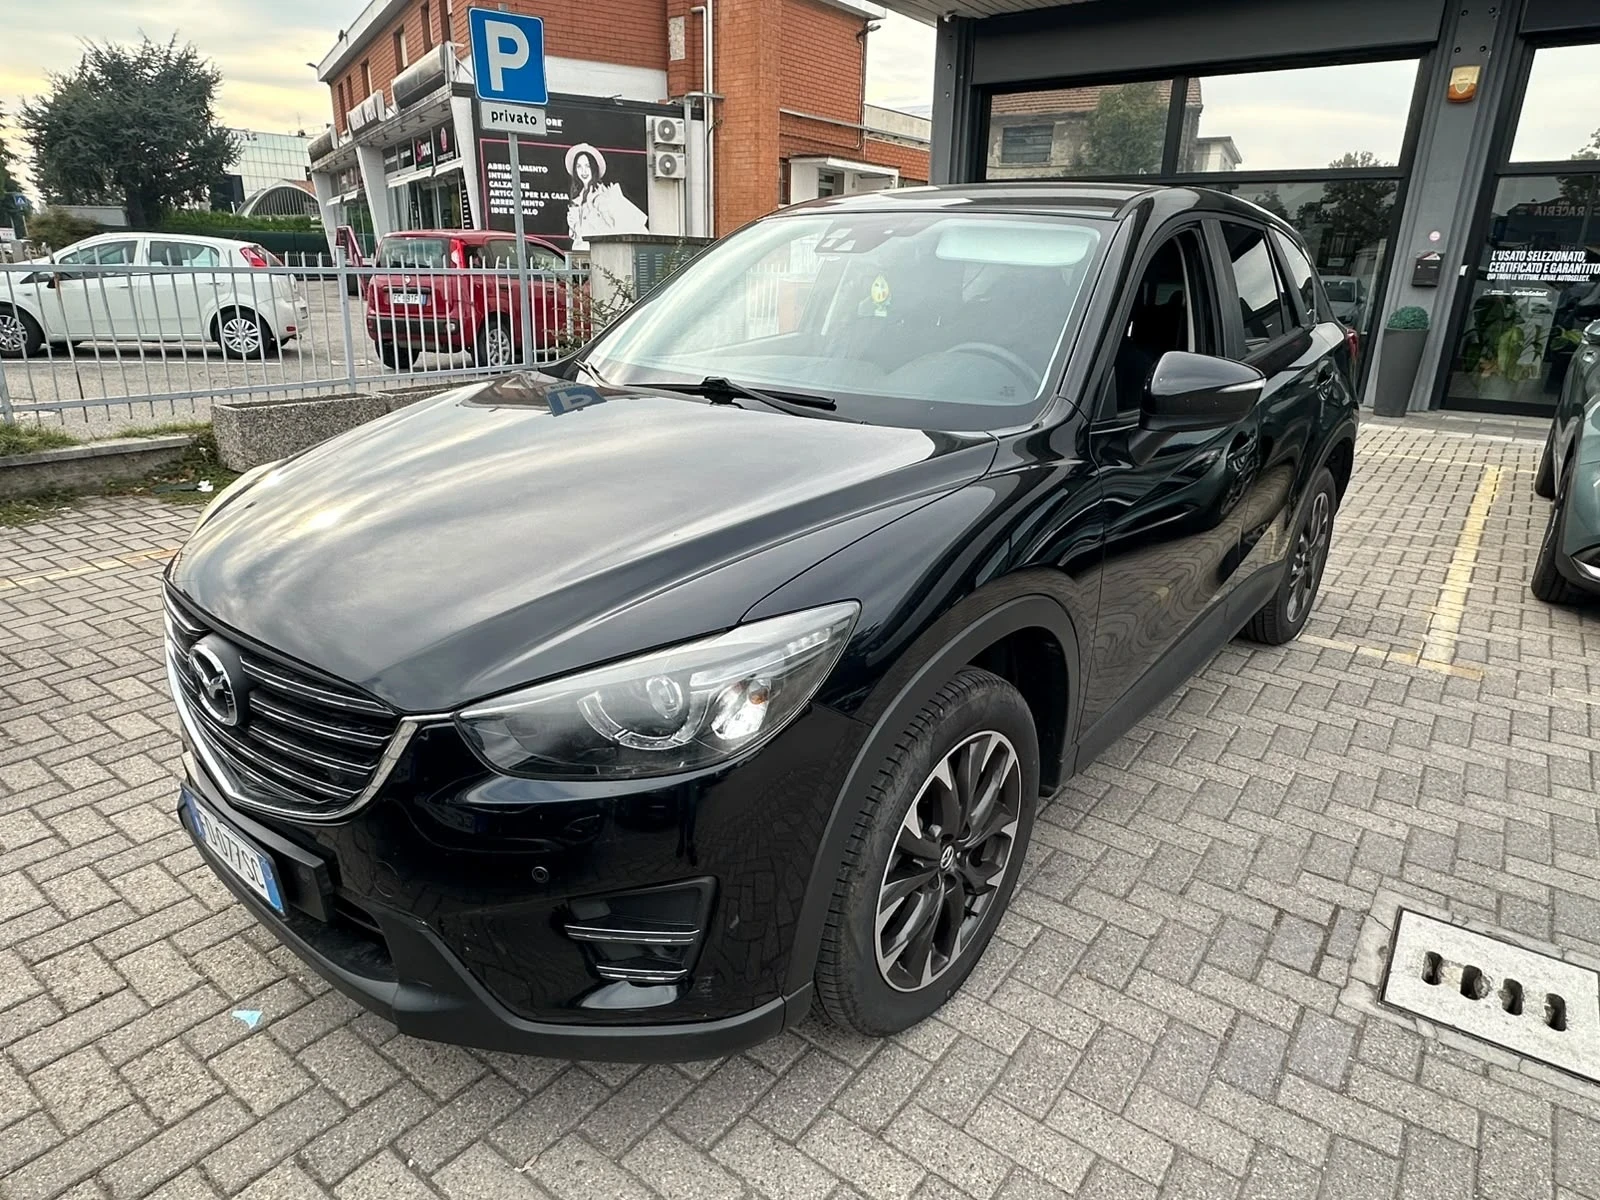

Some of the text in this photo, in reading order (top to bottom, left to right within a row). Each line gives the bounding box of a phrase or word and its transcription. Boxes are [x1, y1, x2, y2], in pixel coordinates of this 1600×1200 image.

[484, 20, 530, 92] P
[491, 109, 537, 126] privato
[489, 181, 530, 189] CALZARE
[540, 192, 550, 200] LA
[490, 198, 545, 207] ARREDMENTO
[1491, 250, 1586, 263] L'USATO SELEZIONATO,
[1488, 262, 1543, 274] CERTIFICATO
[1542, 264, 1549, 274] E
